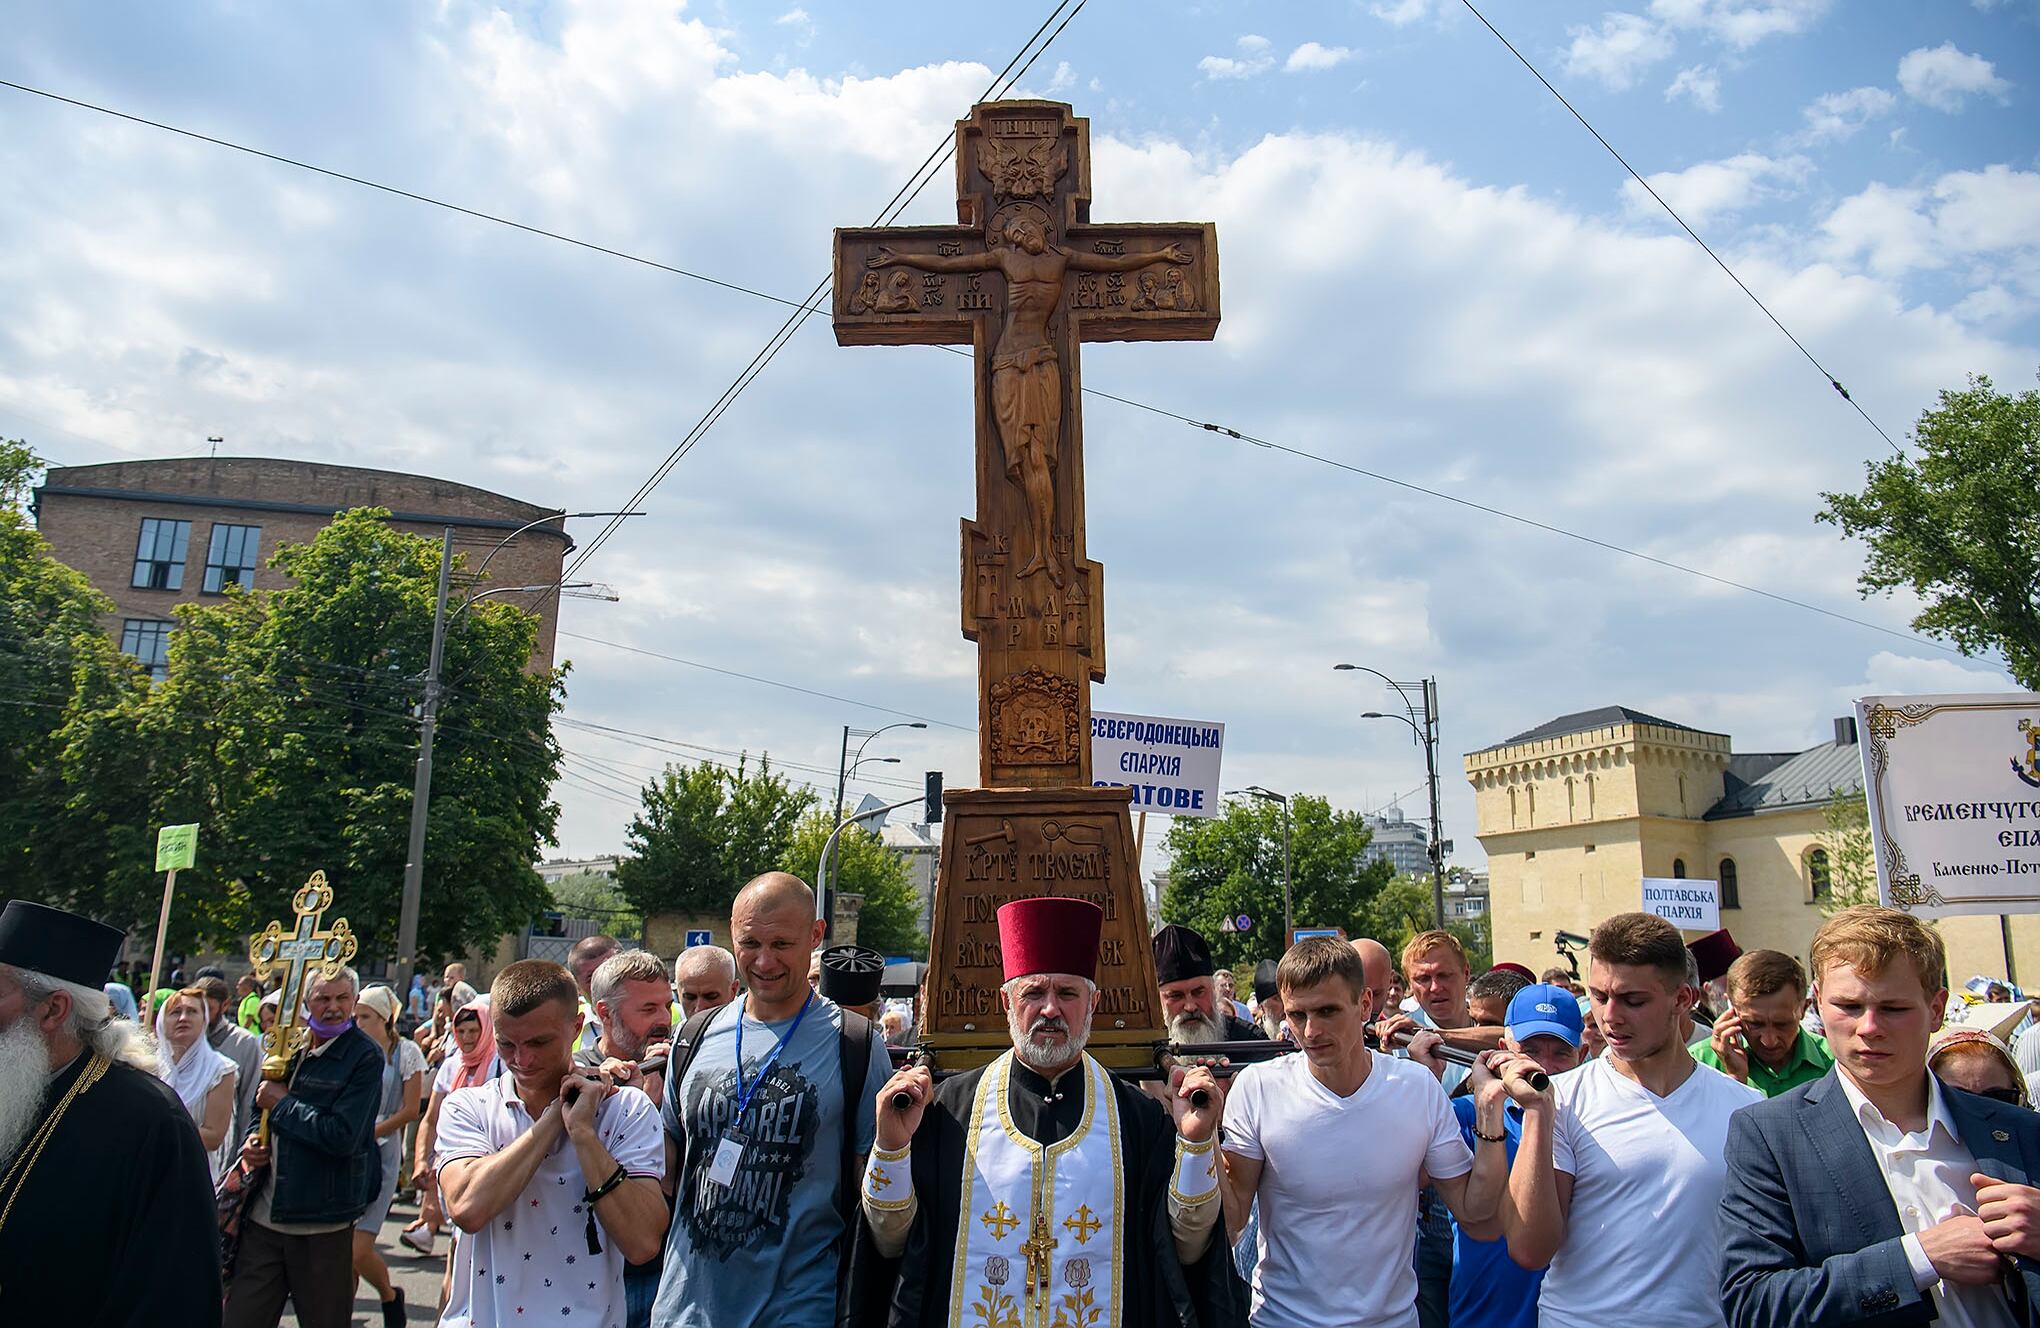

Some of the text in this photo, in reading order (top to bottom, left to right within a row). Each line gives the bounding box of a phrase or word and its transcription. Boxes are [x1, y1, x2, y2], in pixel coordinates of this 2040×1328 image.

[1093, 780, 1204, 810] АТОВЕ
[1645, 888, 1715, 903] ПОЛТАВСЬКА
[765, 1075, 791, 1094] LABEL
